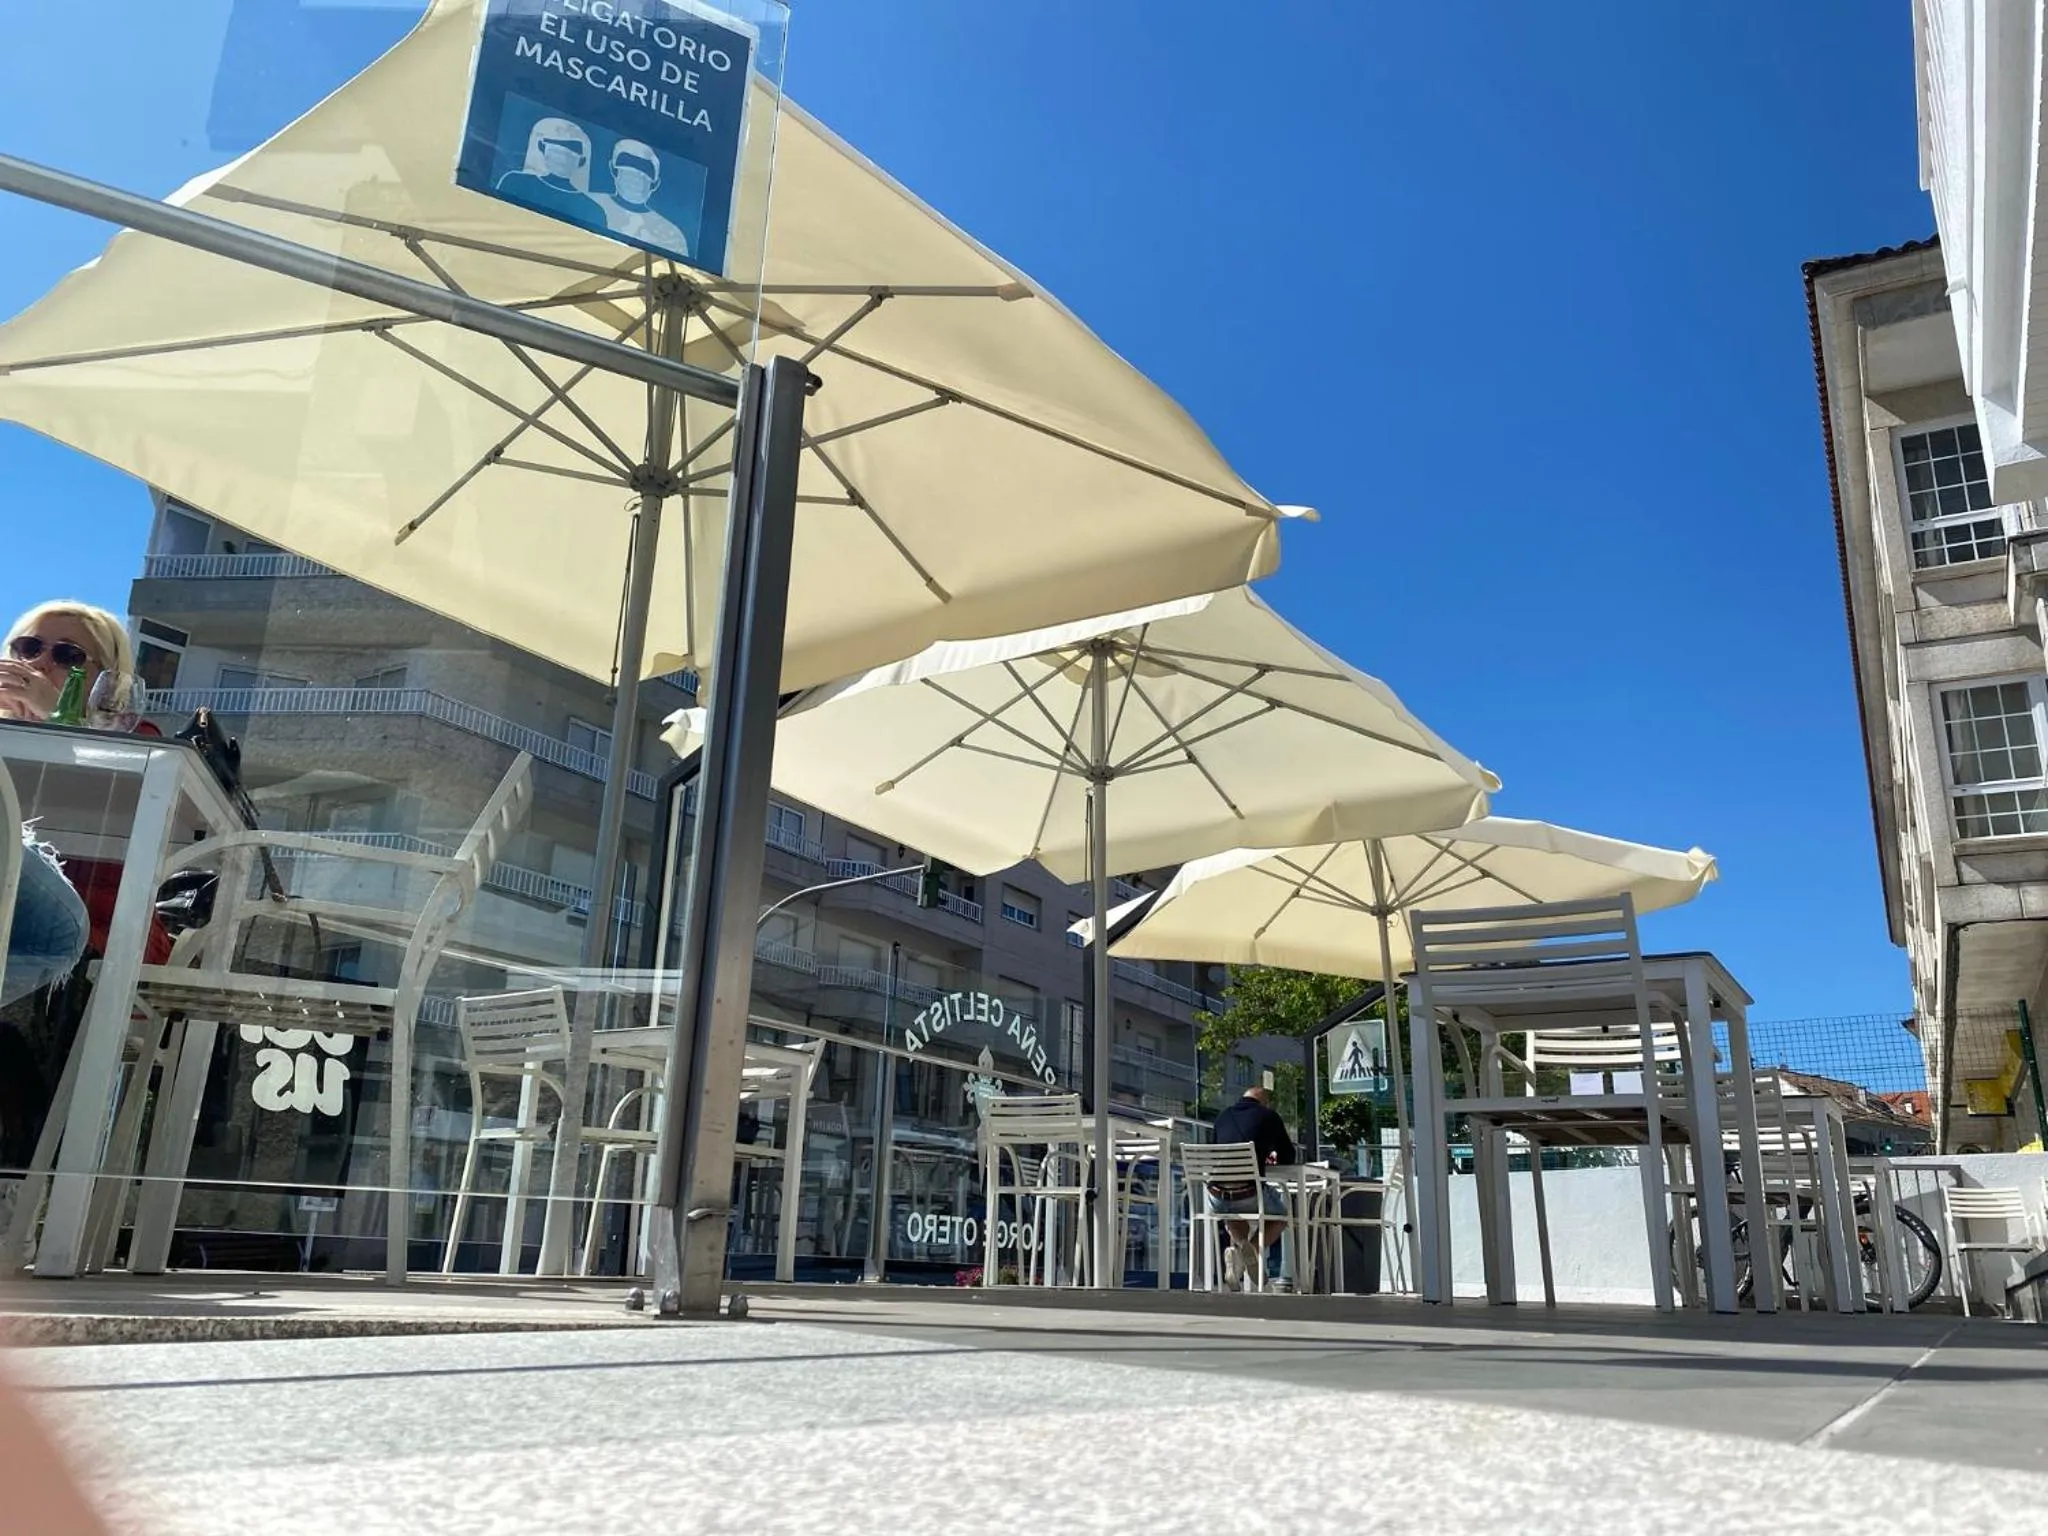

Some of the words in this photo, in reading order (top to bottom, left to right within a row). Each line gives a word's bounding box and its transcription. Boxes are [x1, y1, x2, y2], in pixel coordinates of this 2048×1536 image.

[540, 12, 575, 44] EL
[586, 29, 650, 72] USO
[660, 60, 700, 94] DE
[554, 0, 731, 72] LIGATORIO
[515, 36, 713, 132] MASCARILLA
